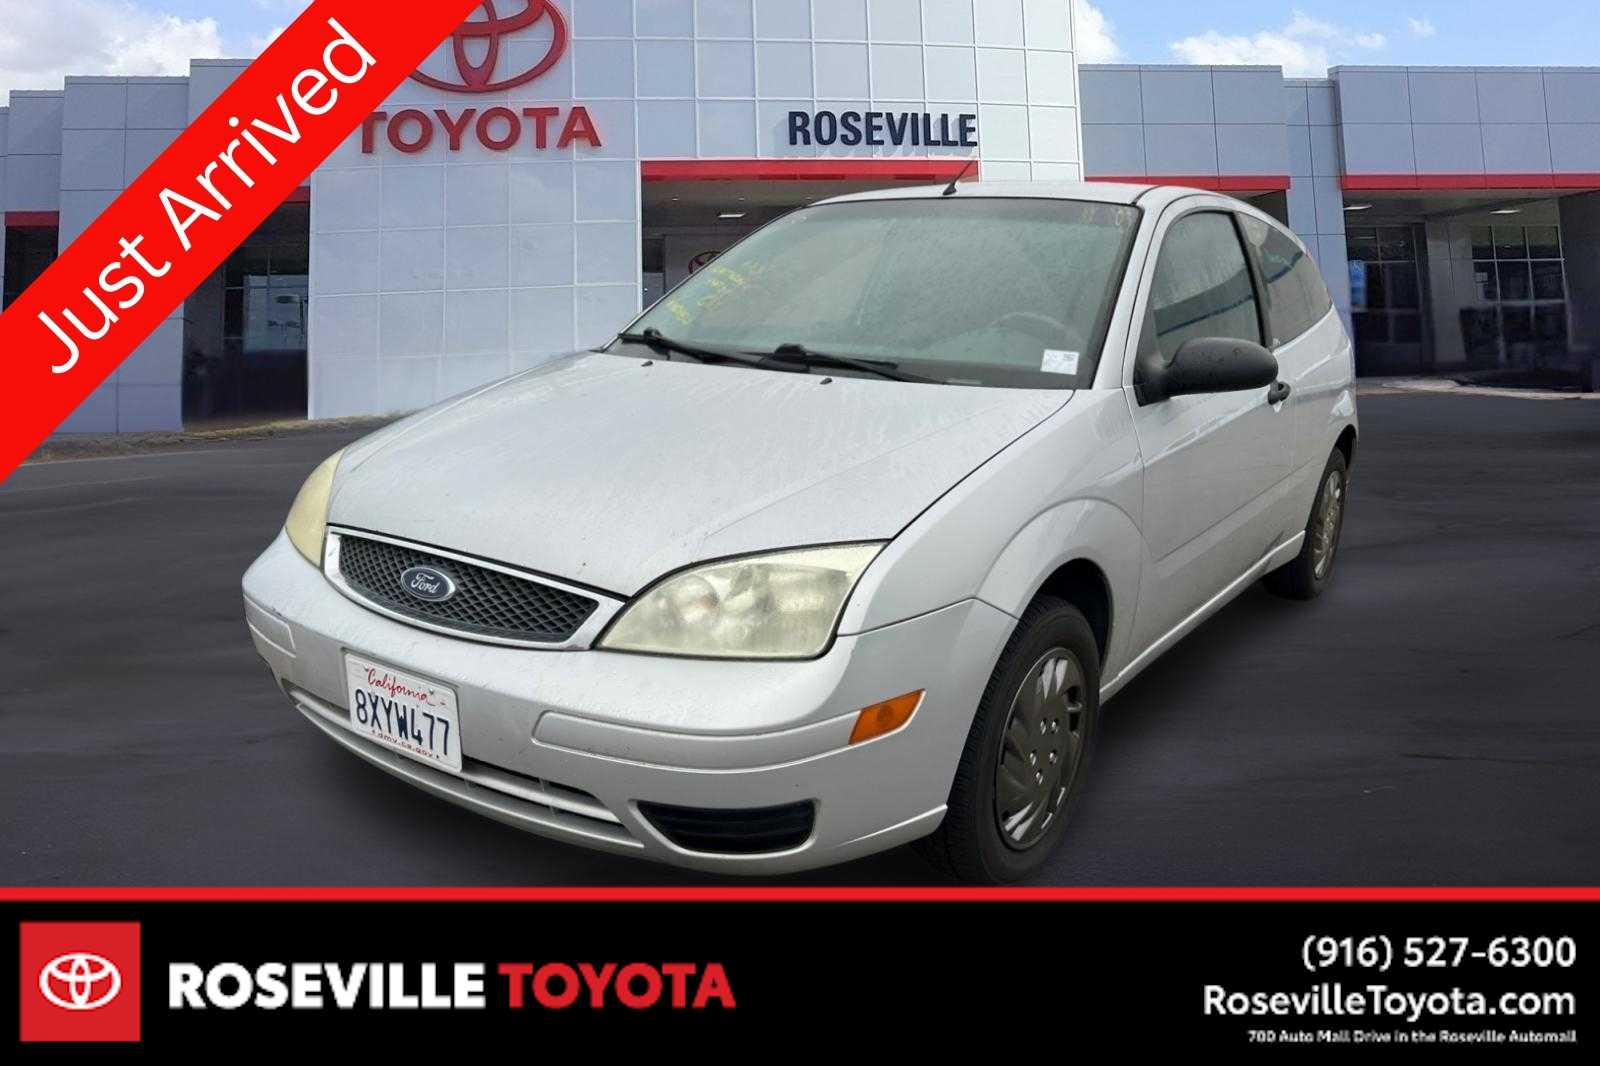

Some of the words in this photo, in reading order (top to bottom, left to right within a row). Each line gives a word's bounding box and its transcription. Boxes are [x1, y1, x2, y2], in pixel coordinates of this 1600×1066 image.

[361, 106, 602, 154] TOYOTA
[788, 110, 978, 147] ROSEVILLE
[411, 572, 440, 593] Ford
[368, 668, 428, 702] California
[355, 688, 449, 756] 8XYW477
